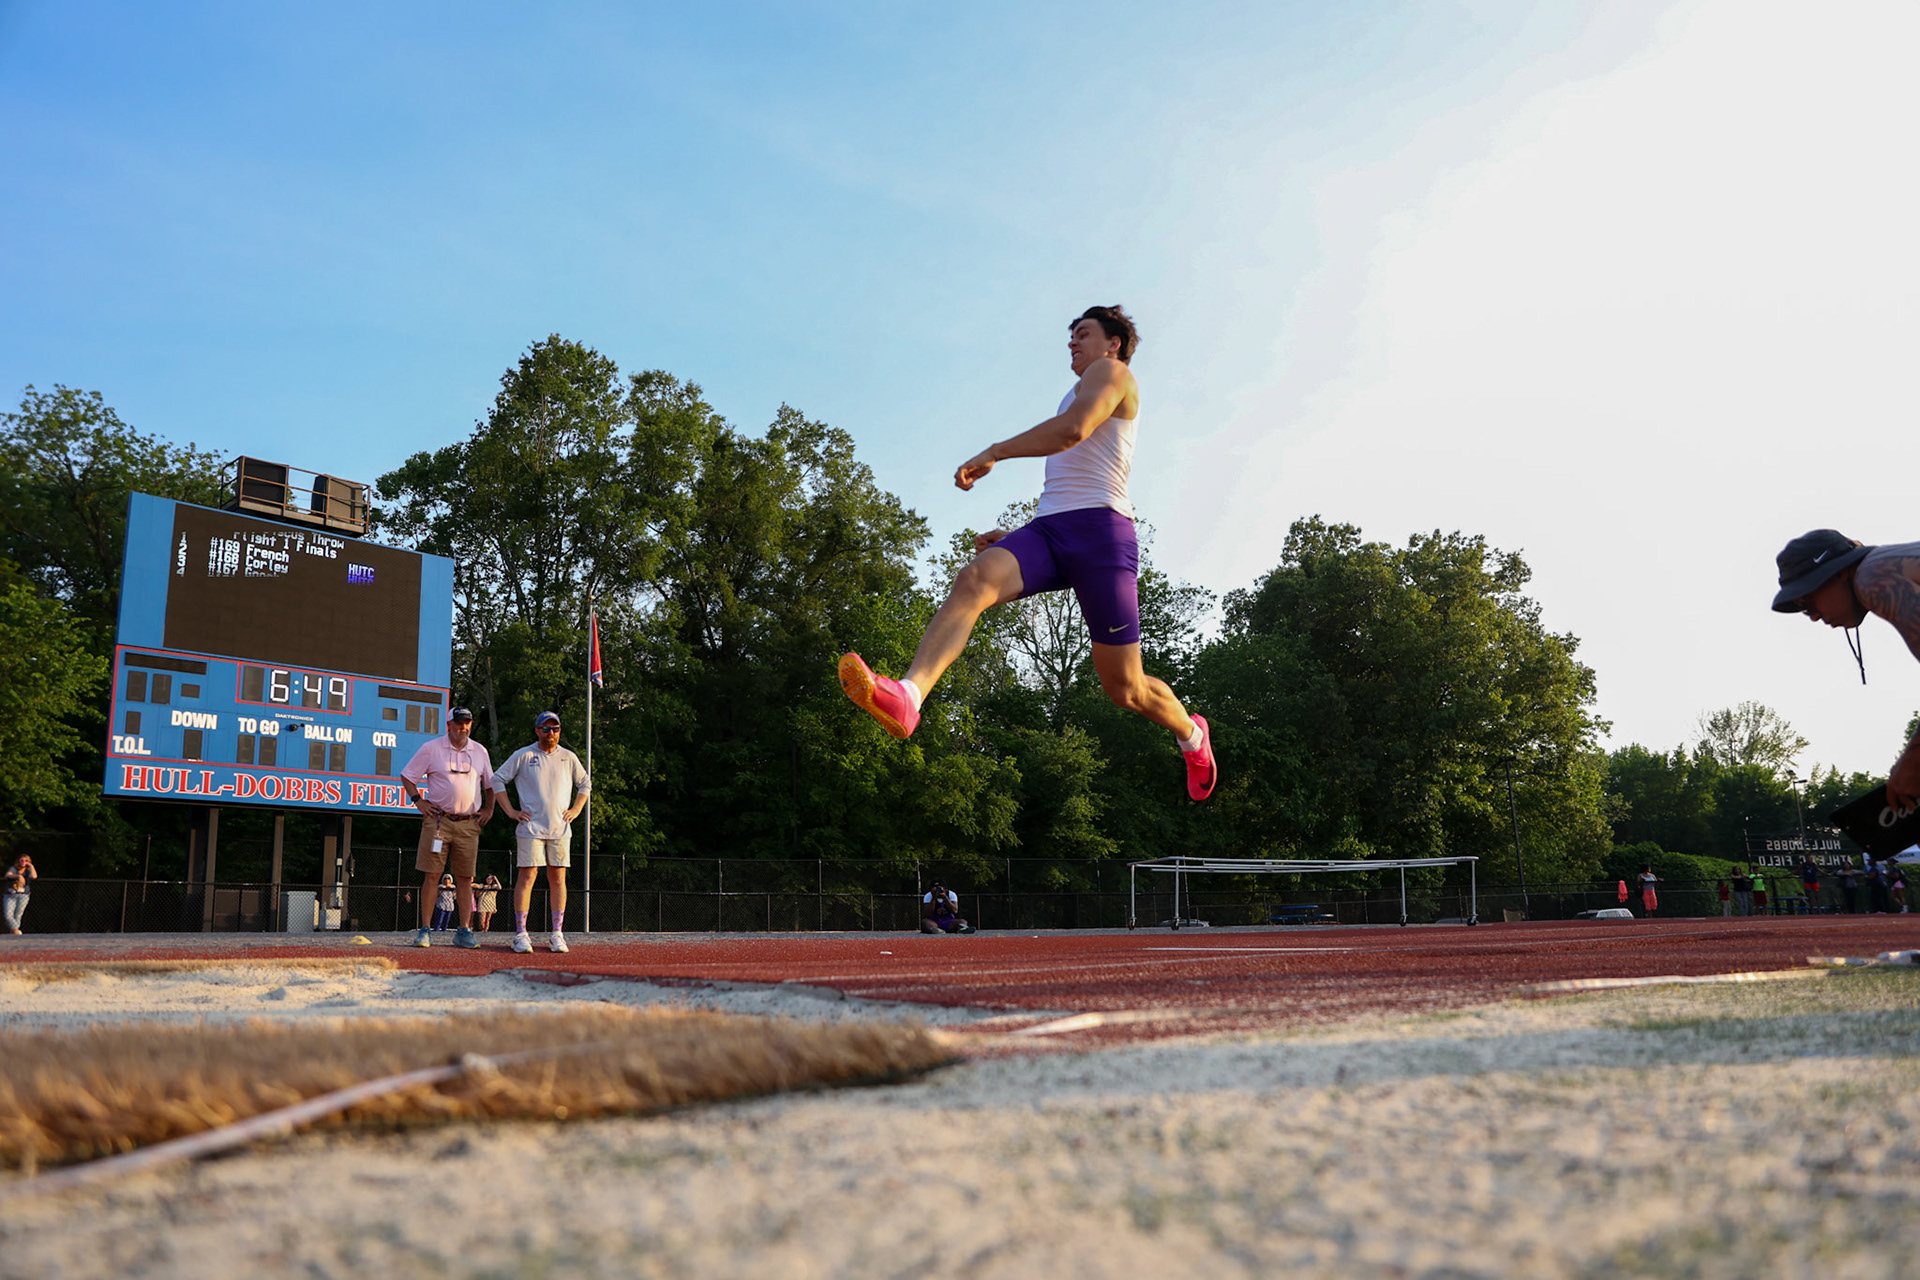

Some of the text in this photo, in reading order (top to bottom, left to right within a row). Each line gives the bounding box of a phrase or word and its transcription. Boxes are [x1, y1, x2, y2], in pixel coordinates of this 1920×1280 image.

[296, 540, 337, 559] Finals
[311, 532, 345, 549] Throw
[177, 555, 186, 568] 3
[207, 560, 238, 575] #167
[178, 543, 188, 555] 2
[209, 548, 239, 564] #168
[245, 555, 289, 574] Corley
[210, 537, 240, 552] #169
[246, 543, 289, 563] French
[347, 563, 375, 578] HUTC
[269, 669, 347, 708] 6:49
[171, 710, 218, 730] DOWN
[238, 717, 280, 736] TO GO
[274, 712, 315, 722] DAKTRONICS
[304, 724, 352, 743] BALL ON
[372, 731, 397, 748] QTR
[112, 735, 152, 755] T.O.L.
[120, 764, 342, 804] HULL-DOBBS
